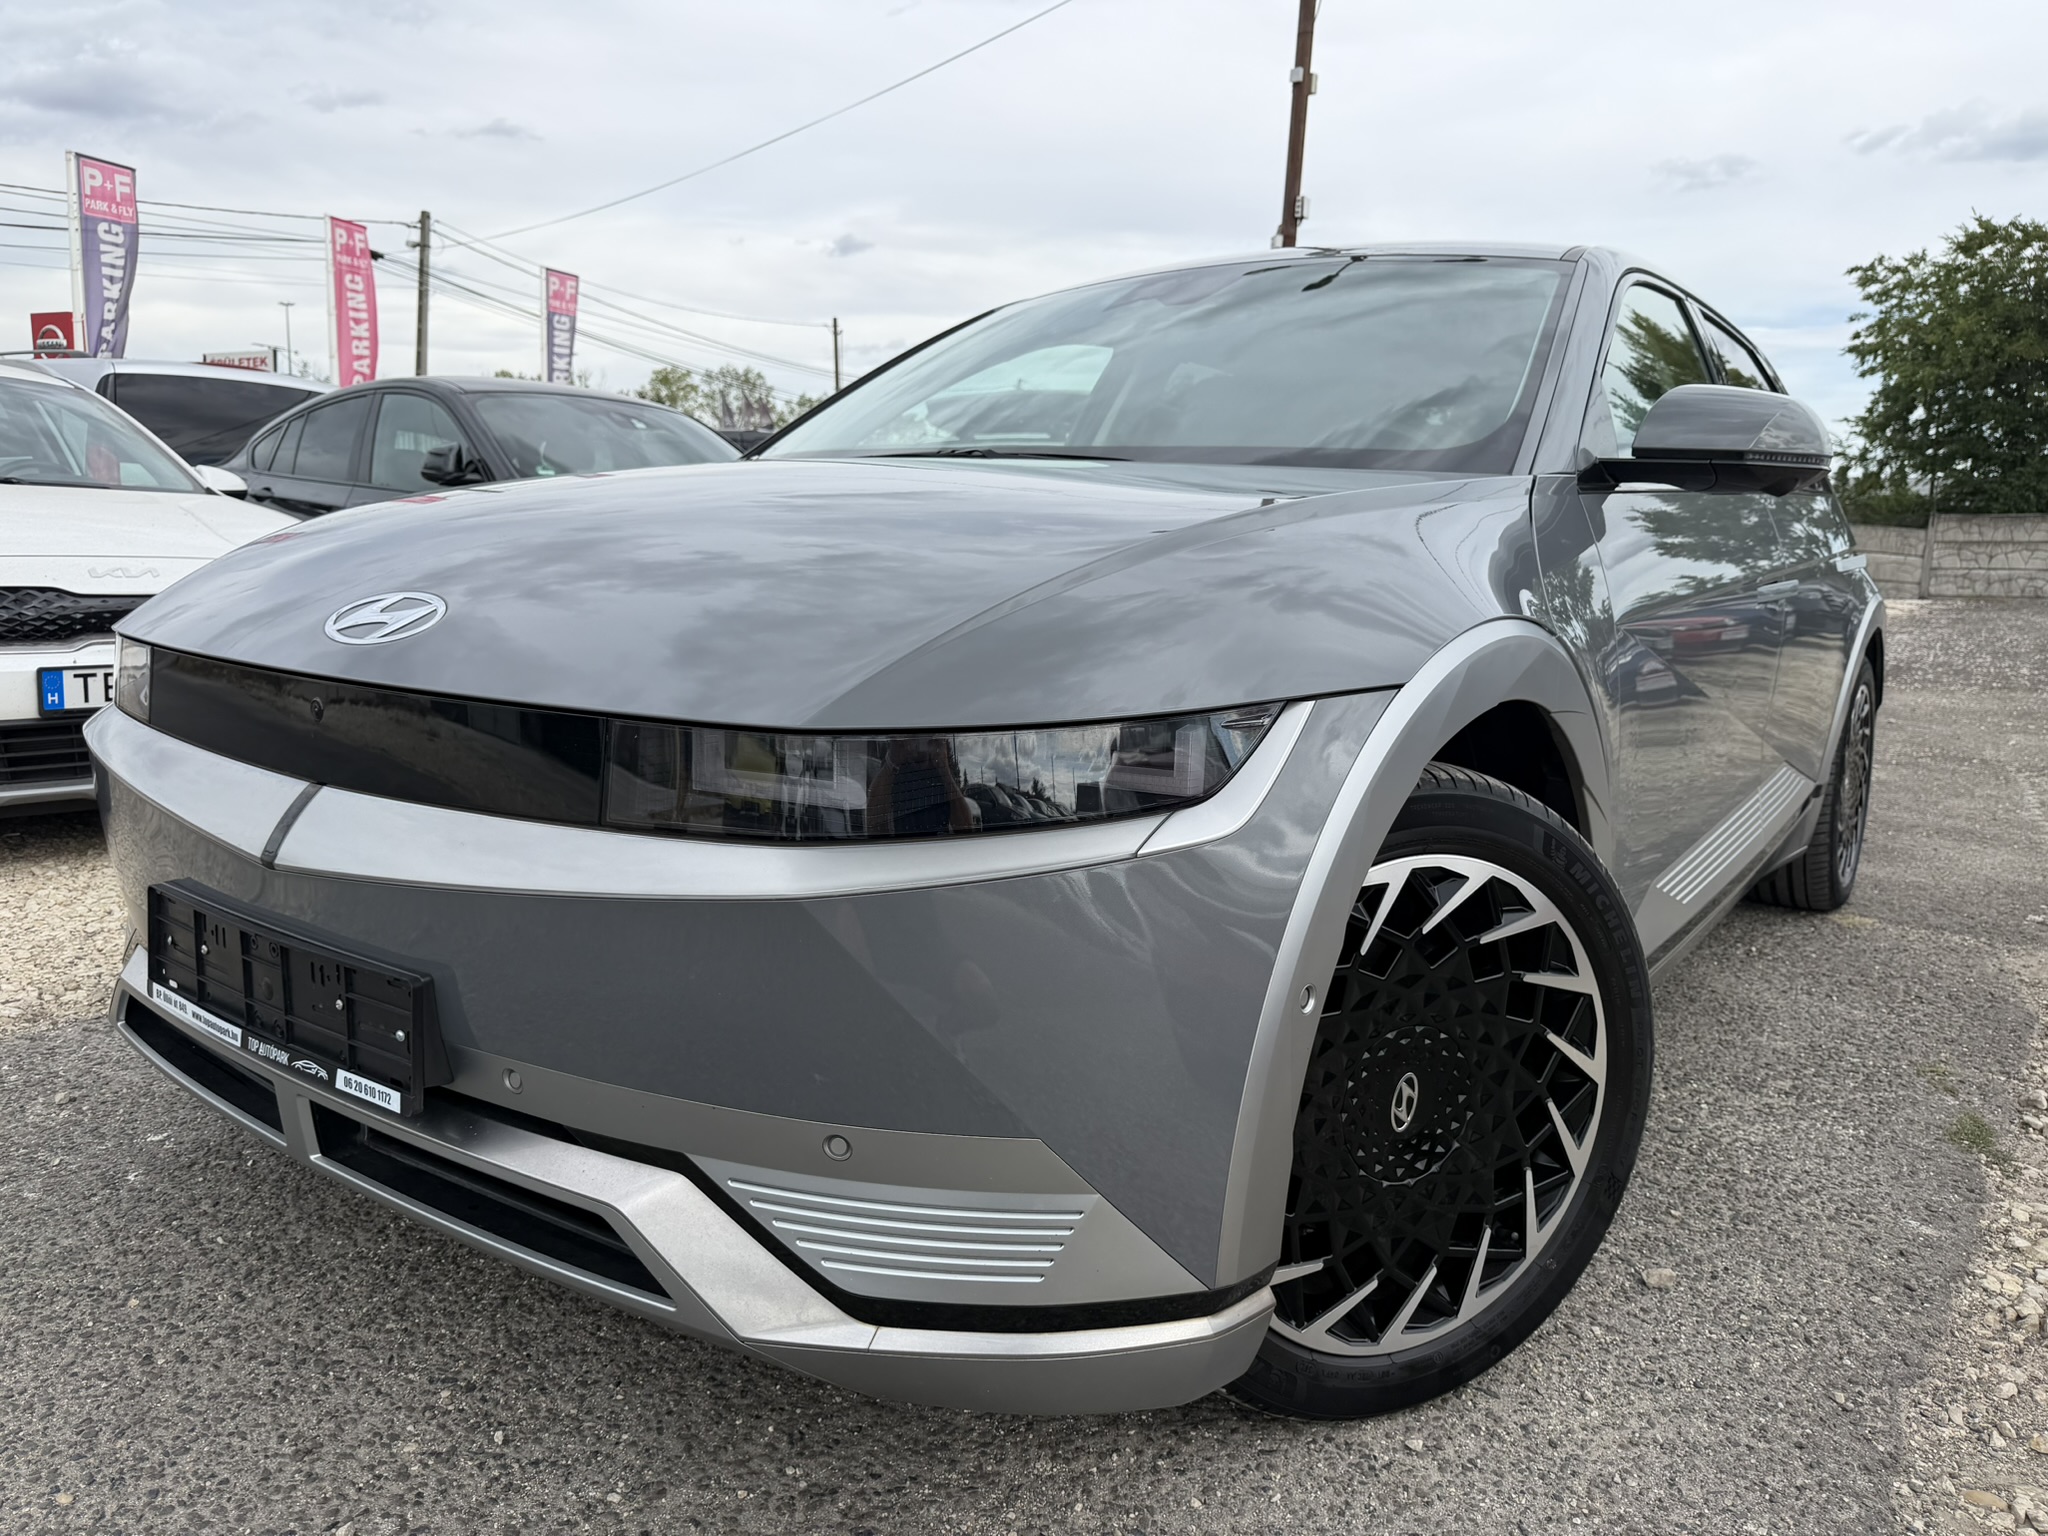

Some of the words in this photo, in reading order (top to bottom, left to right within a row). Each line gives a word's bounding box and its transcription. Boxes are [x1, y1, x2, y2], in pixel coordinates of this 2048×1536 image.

[83, 166, 131, 202] P+F
[85, 197, 109, 213] PARK
[111, 204, 117, 214] &
[118, 205, 134, 217] FLY
[97, 221, 125, 358] PARKING
[345, 273, 370, 386] PARKING
[552, 315, 571, 384] RKING
[48, 692, 59, 705] H
[1569, 861, 1642, 998] MICHELIN
[248, 1036, 260, 1053] TOP
[343, 1076, 354, 1090] 06
[354, 1079, 363, 1094] 20
[364, 1083, 376, 1099] 610
[377, 1089, 392, 1105] 1172
